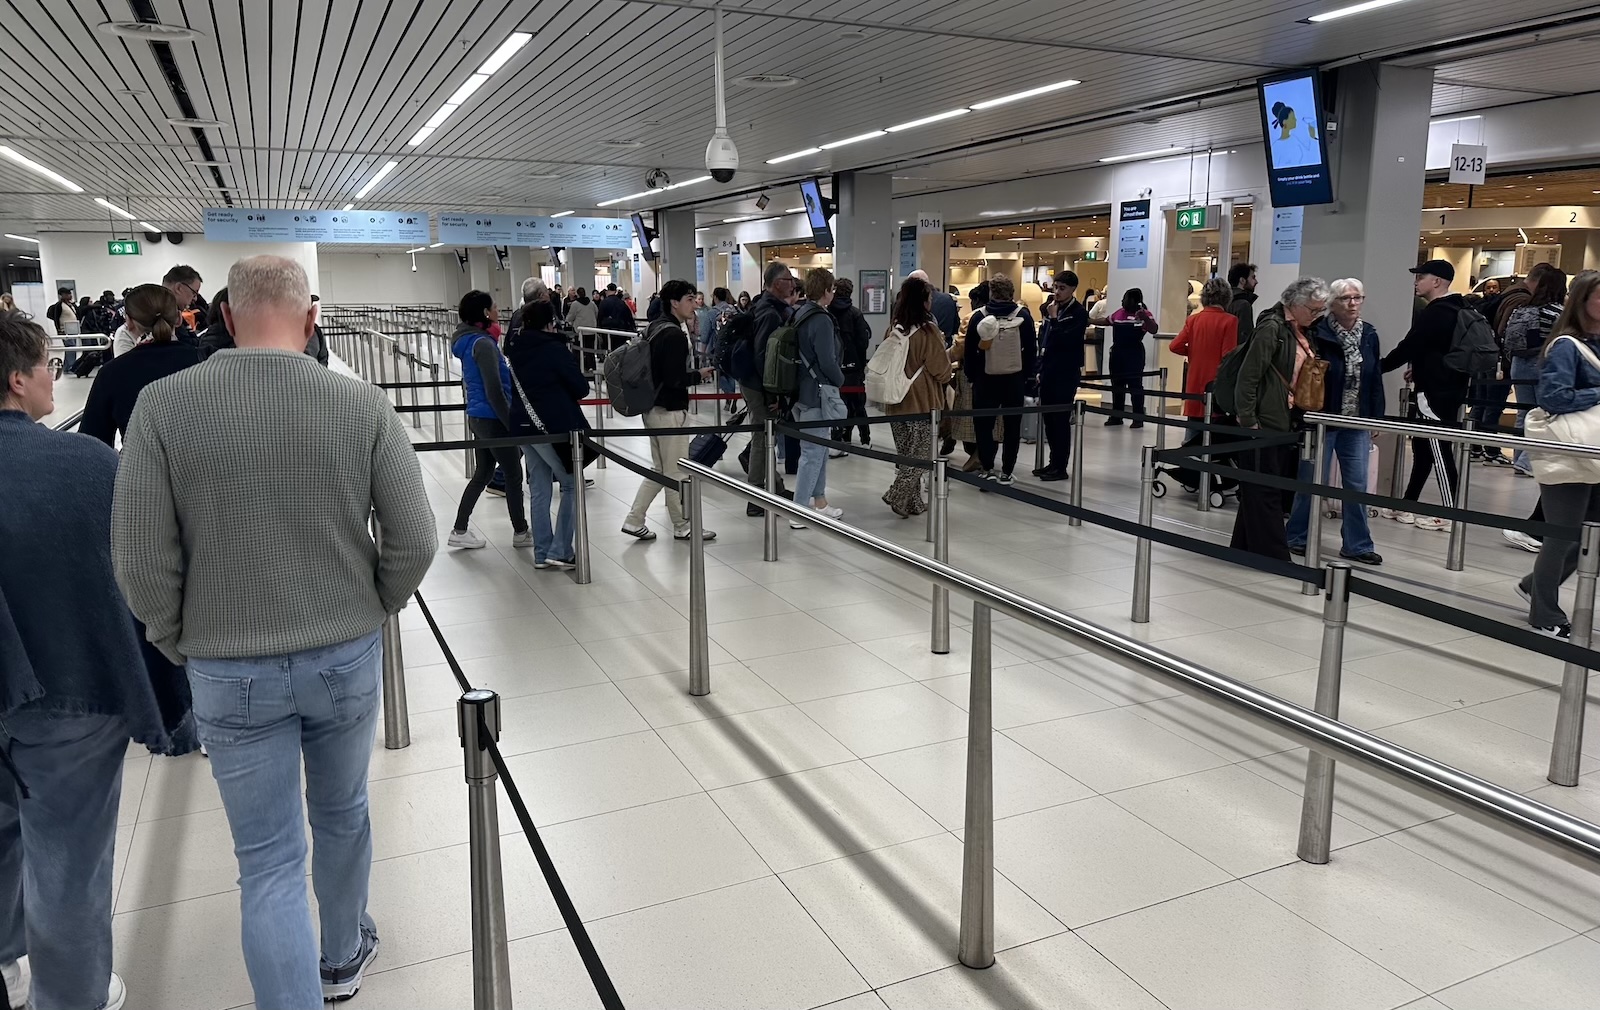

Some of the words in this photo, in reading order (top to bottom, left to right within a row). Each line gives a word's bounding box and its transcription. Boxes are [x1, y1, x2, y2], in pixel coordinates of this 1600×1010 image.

[1454, 156, 1483, 172] 12-13
[920, 218, 940, 228] 10-11
[1439, 214, 1446, 225] 1
[1569, 212, 1577, 223] 2
